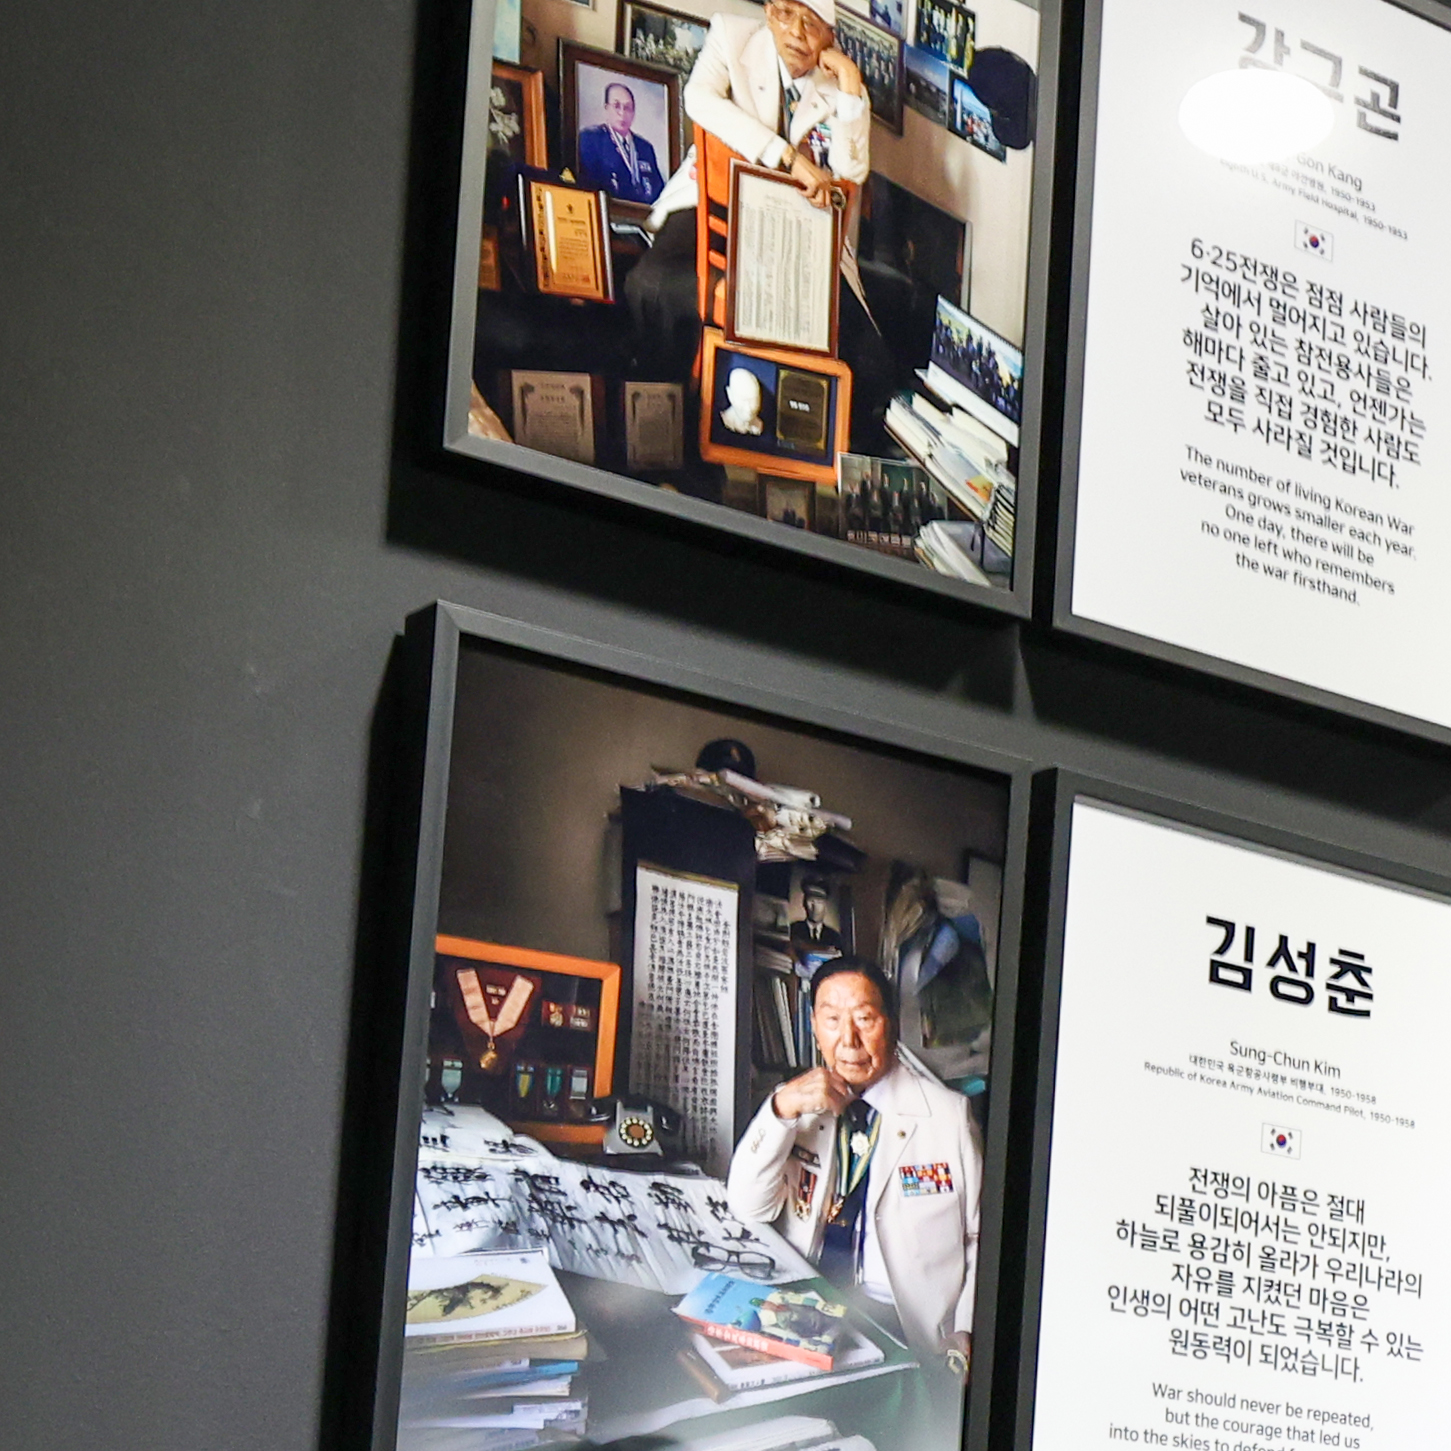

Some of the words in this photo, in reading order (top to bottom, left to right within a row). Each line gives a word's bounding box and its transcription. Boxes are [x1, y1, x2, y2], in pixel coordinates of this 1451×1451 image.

[1180, 264, 1262, 317] 기억에서
[1268, 296, 1345, 346] 멀어지고
[1352, 330, 1431, 380] 있습니다.
[1190, 238, 1299, 299] 6·25전쟁은
[1306, 281, 1343, 317] 점점
[1349, 299, 1426, 349] 사람들의
[1182, 327, 1245, 372] 해마다
[1252, 354, 1290, 387] 줄고
[1296, 370, 1341, 408] 있고,
[1349, 390, 1425, 438] 언젠가는
[1201, 303, 1242, 340] 살아
[1248, 321, 1288, 356] 있는
[1295, 338, 1412, 403] 참전용사들은
[1186, 360, 1246, 404] 전쟁을
[1255, 386, 1293, 422] 직접
[1301, 403, 1358, 443] 경험한
[1363, 427, 1418, 464] 사람도
[1204, 399, 1246, 433] 모두
[1252, 417, 1313, 459] 사라질
[1320, 439, 1399, 488] 것입니다.
[1205, 914, 1374, 1018] 김성춘
[1229, 1040, 1310, 1072] Sung-Chun
[1313, 1059, 1341, 1079] Kim
[1154, 1193, 1301, 1245] 되풀이되어서는
[1307, 1222, 1390, 1262] 안되지만,
[1188, 1166, 1251, 1203] 전쟁의
[1256, 1180, 1320, 1216] 아픔은
[1326, 1193, 1365, 1225] 절대
[1115, 1218, 1181, 1253] 하늘로
[1187, 1232, 1251, 1269] 용감히
[1258, 1244, 1319, 1280] 올라가
[1324, 1257, 1422, 1299] 우리나라의
[1170, 1263, 1236, 1299] 자유를
[1241, 1275, 1302, 1310] 지켰던
[1308, 1287, 1370, 1321] 마음은
[1107, 1284, 1172, 1320] 인생의
[1178, 1297, 1220, 1329] 어떤
[1226, 1305, 1287, 1337] 고난도
[1293, 1315, 1355, 1351] 극복할
[1359, 1328, 1379, 1354] 수
[1385, 1331, 1423, 1361] 있는
[1168, 1327, 1252, 1367] 원동력이
[1258, 1343, 1363, 1383] 되었습니다.
